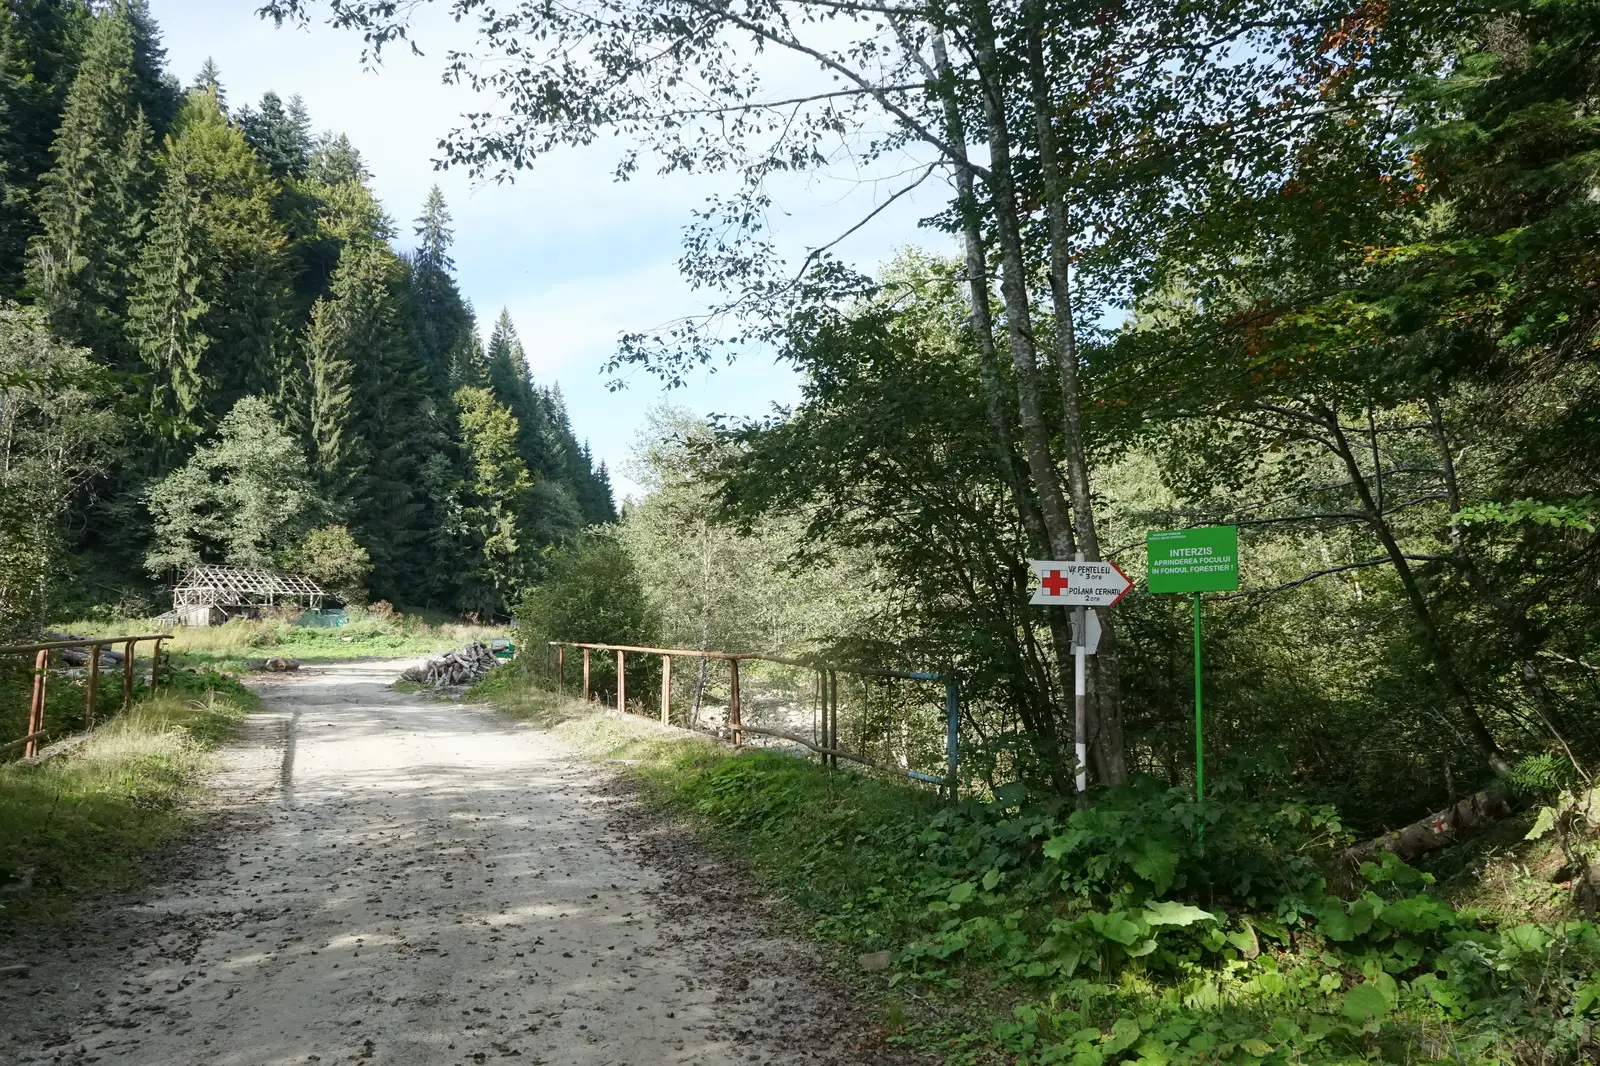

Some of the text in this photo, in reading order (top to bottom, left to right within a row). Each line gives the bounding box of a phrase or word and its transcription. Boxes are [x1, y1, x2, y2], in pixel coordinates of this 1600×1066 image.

[1169, 547, 1213, 557] INTERZIS
[1153, 556, 1231, 566] APRINDEREA FOCULUI
[1077, 566, 1110, 574] PENTELEU
[1160, 566, 1189, 574] FONDUL
[1190, 565, 1229, 573] FORESTIER
